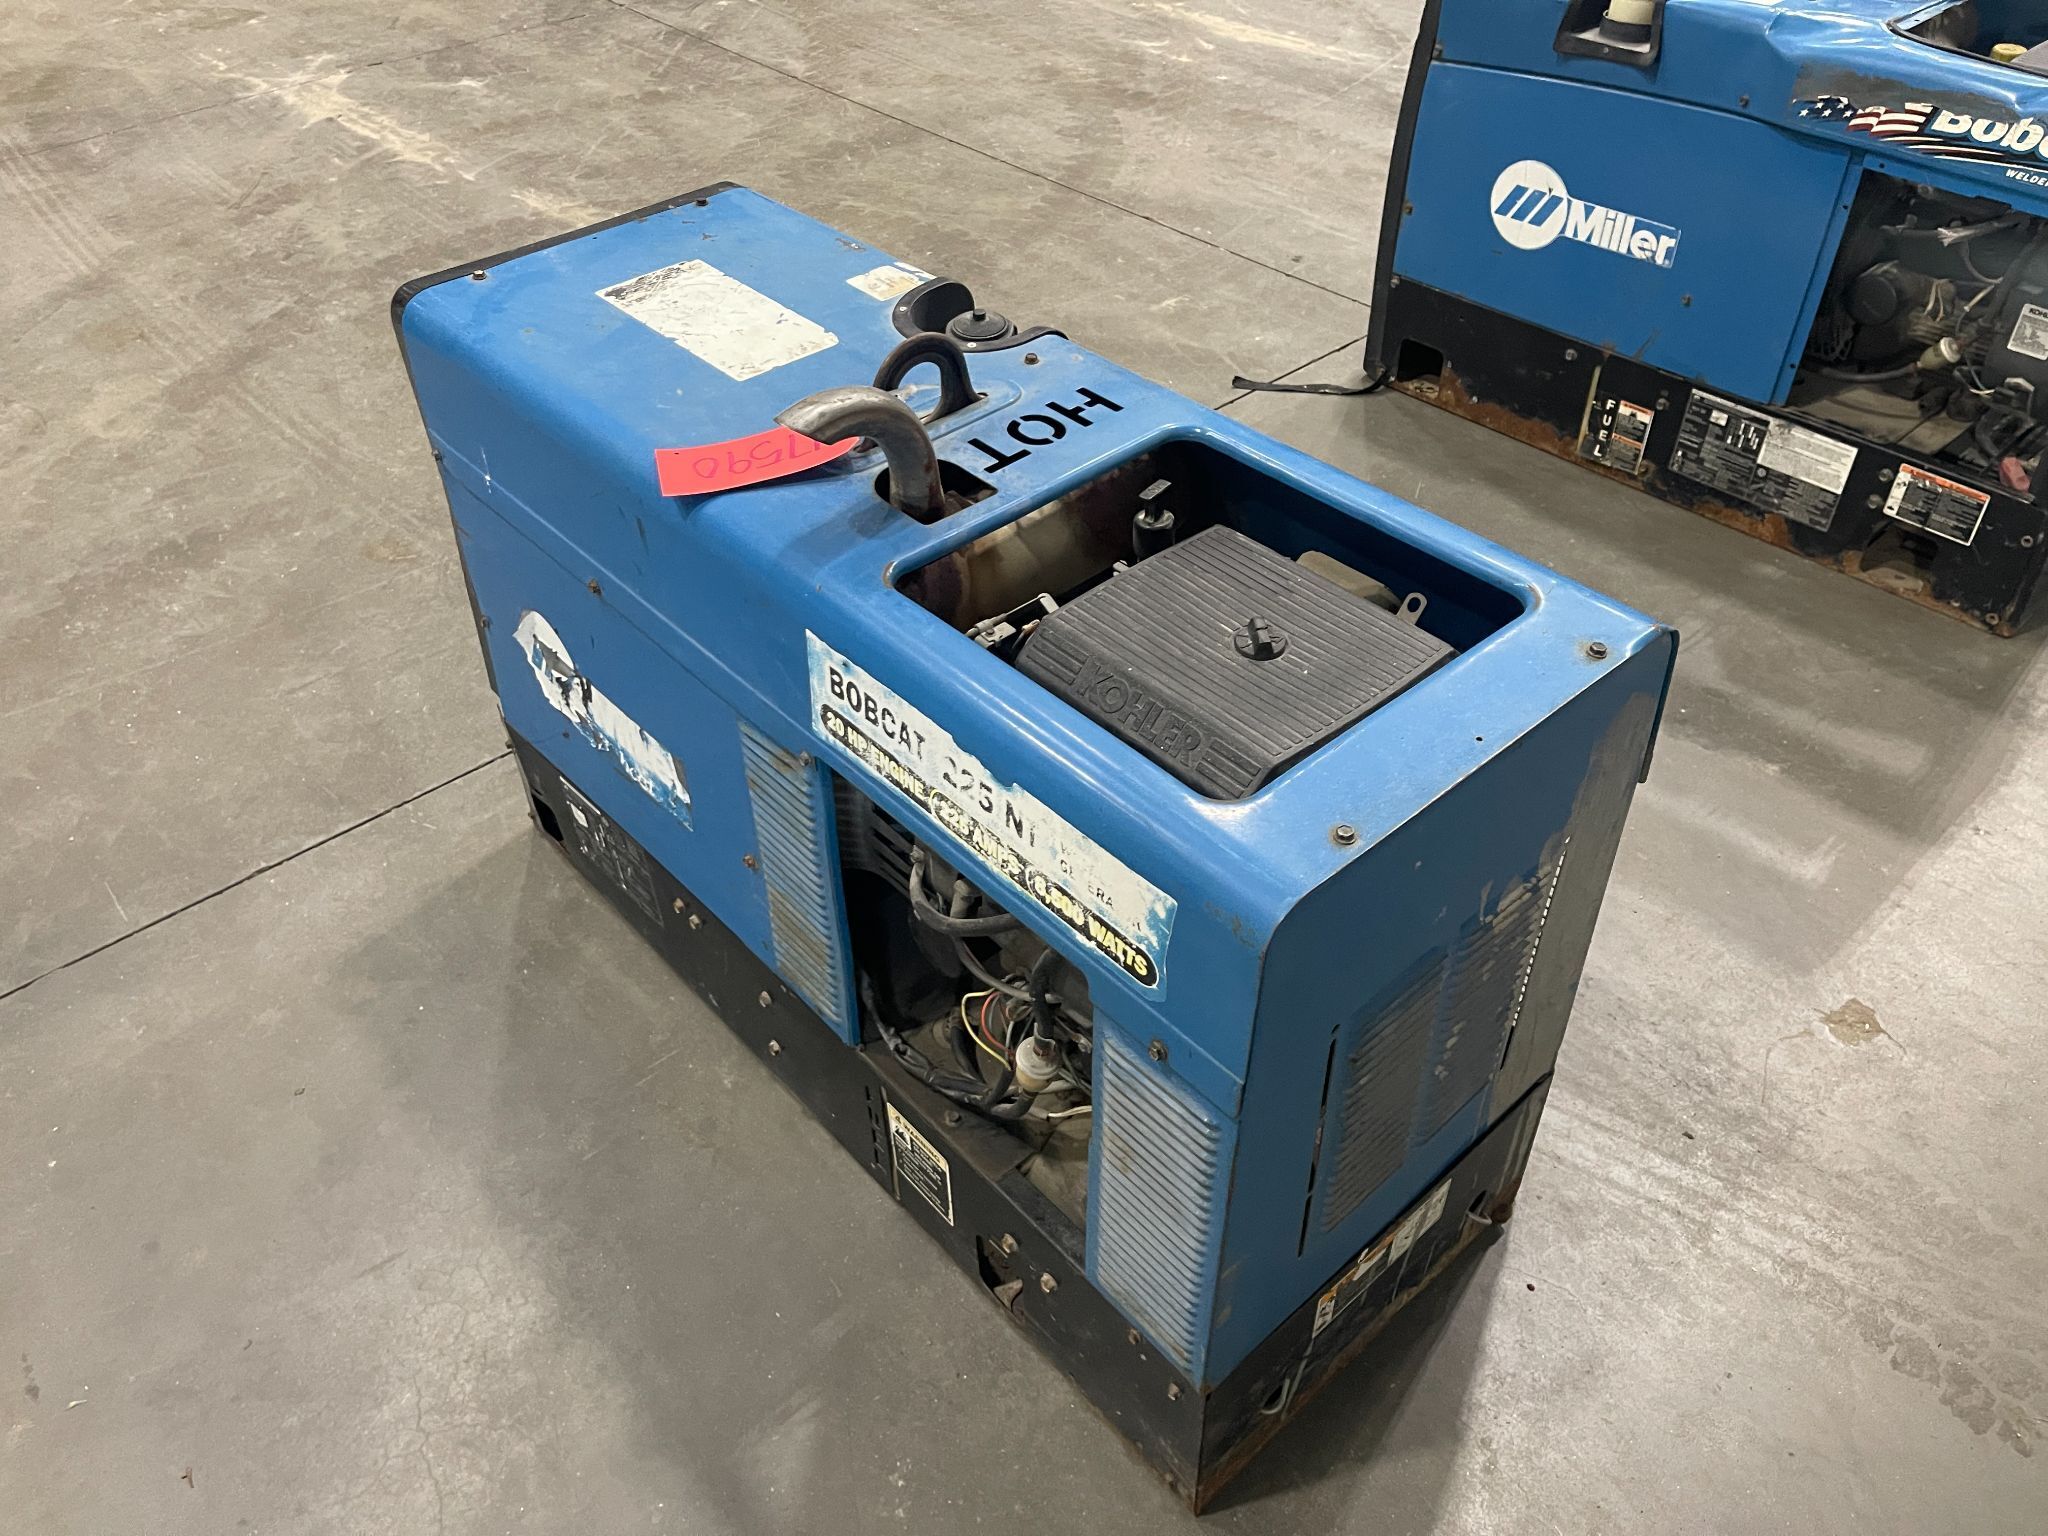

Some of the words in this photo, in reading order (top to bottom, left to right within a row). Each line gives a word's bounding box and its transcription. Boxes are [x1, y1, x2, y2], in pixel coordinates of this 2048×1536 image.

[1565, 199, 1677, 266] Miller
[968, 387, 1124, 473] HOT
[1593, 399, 1616, 457] FUEL
[829, 666, 926, 760] BOBCAT
[1071, 655, 1204, 768] KOHLER
[826, 711, 845, 737] 20
[847, 726, 868, 752] HP
[870, 744, 924, 800] ENGINE
[1088, 915, 1148, 977] WATTS
